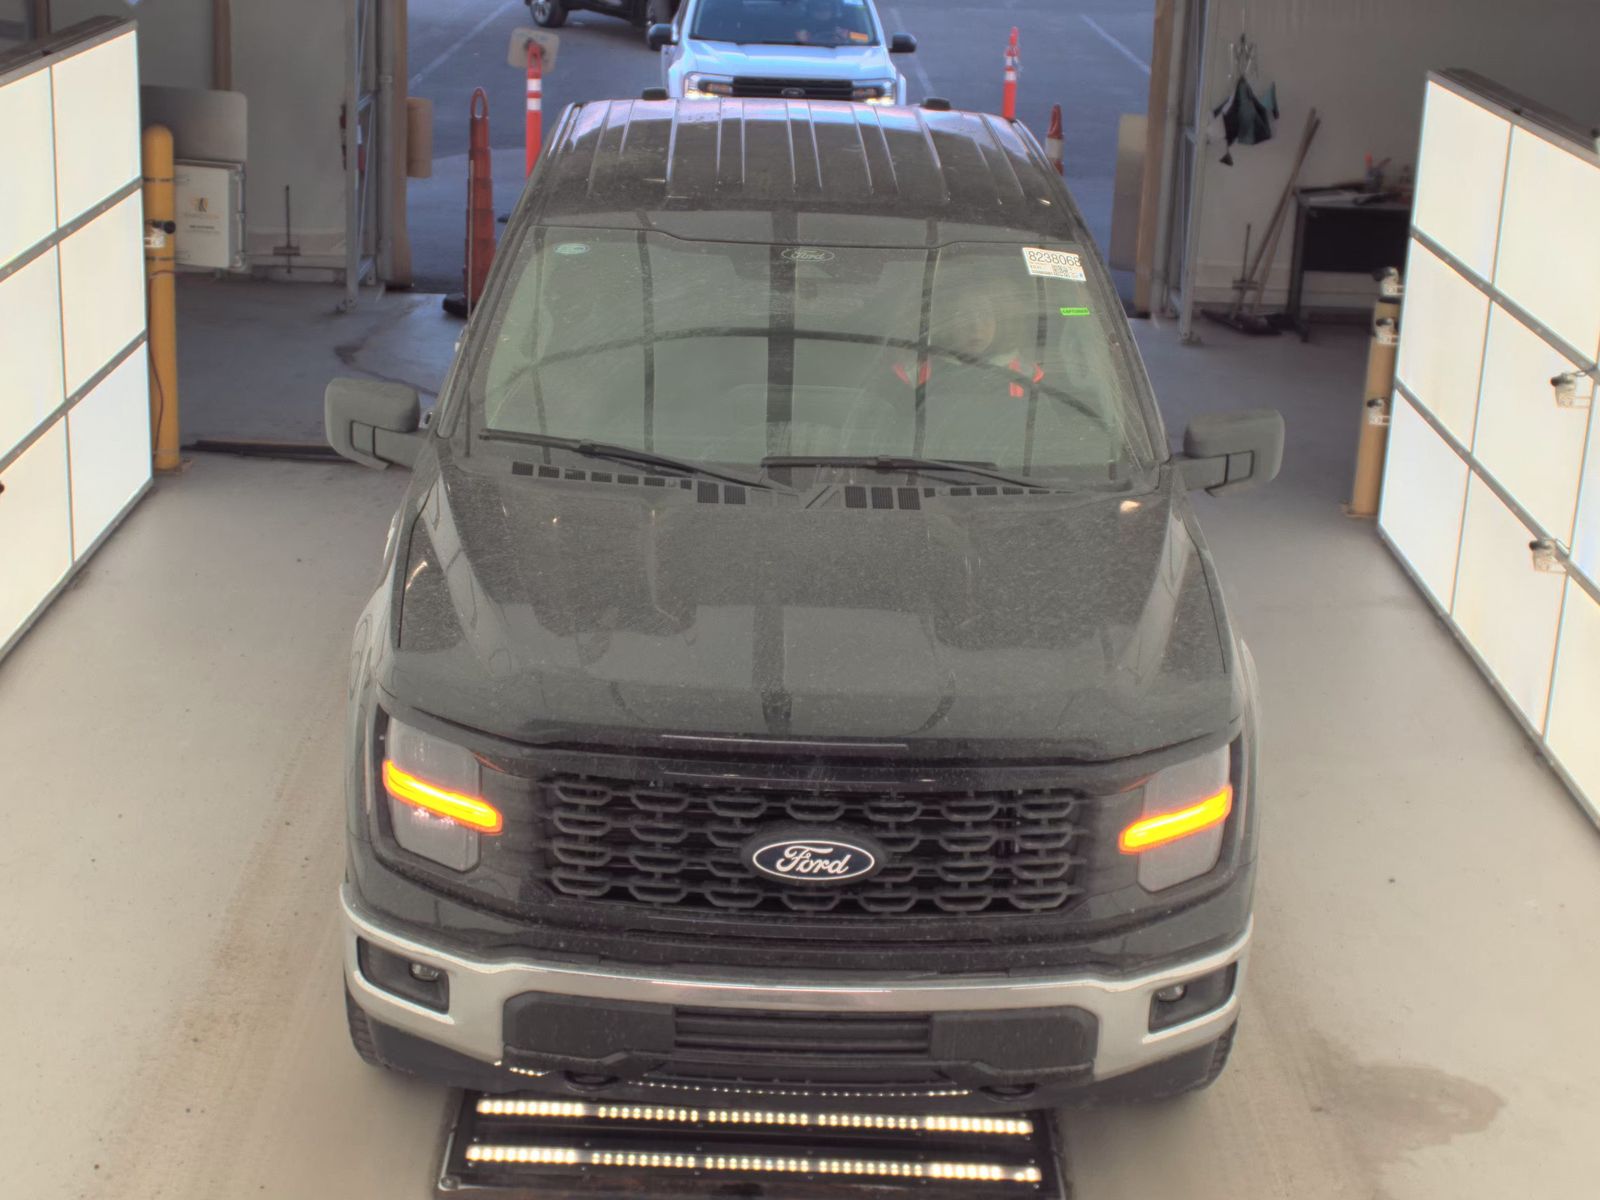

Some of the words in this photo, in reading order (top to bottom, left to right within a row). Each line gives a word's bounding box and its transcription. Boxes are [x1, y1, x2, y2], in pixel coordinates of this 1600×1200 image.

[790, 249, 825, 260] Ford
[1028, 250, 1081, 267] 8238068
[776, 845, 852, 874] Ford
